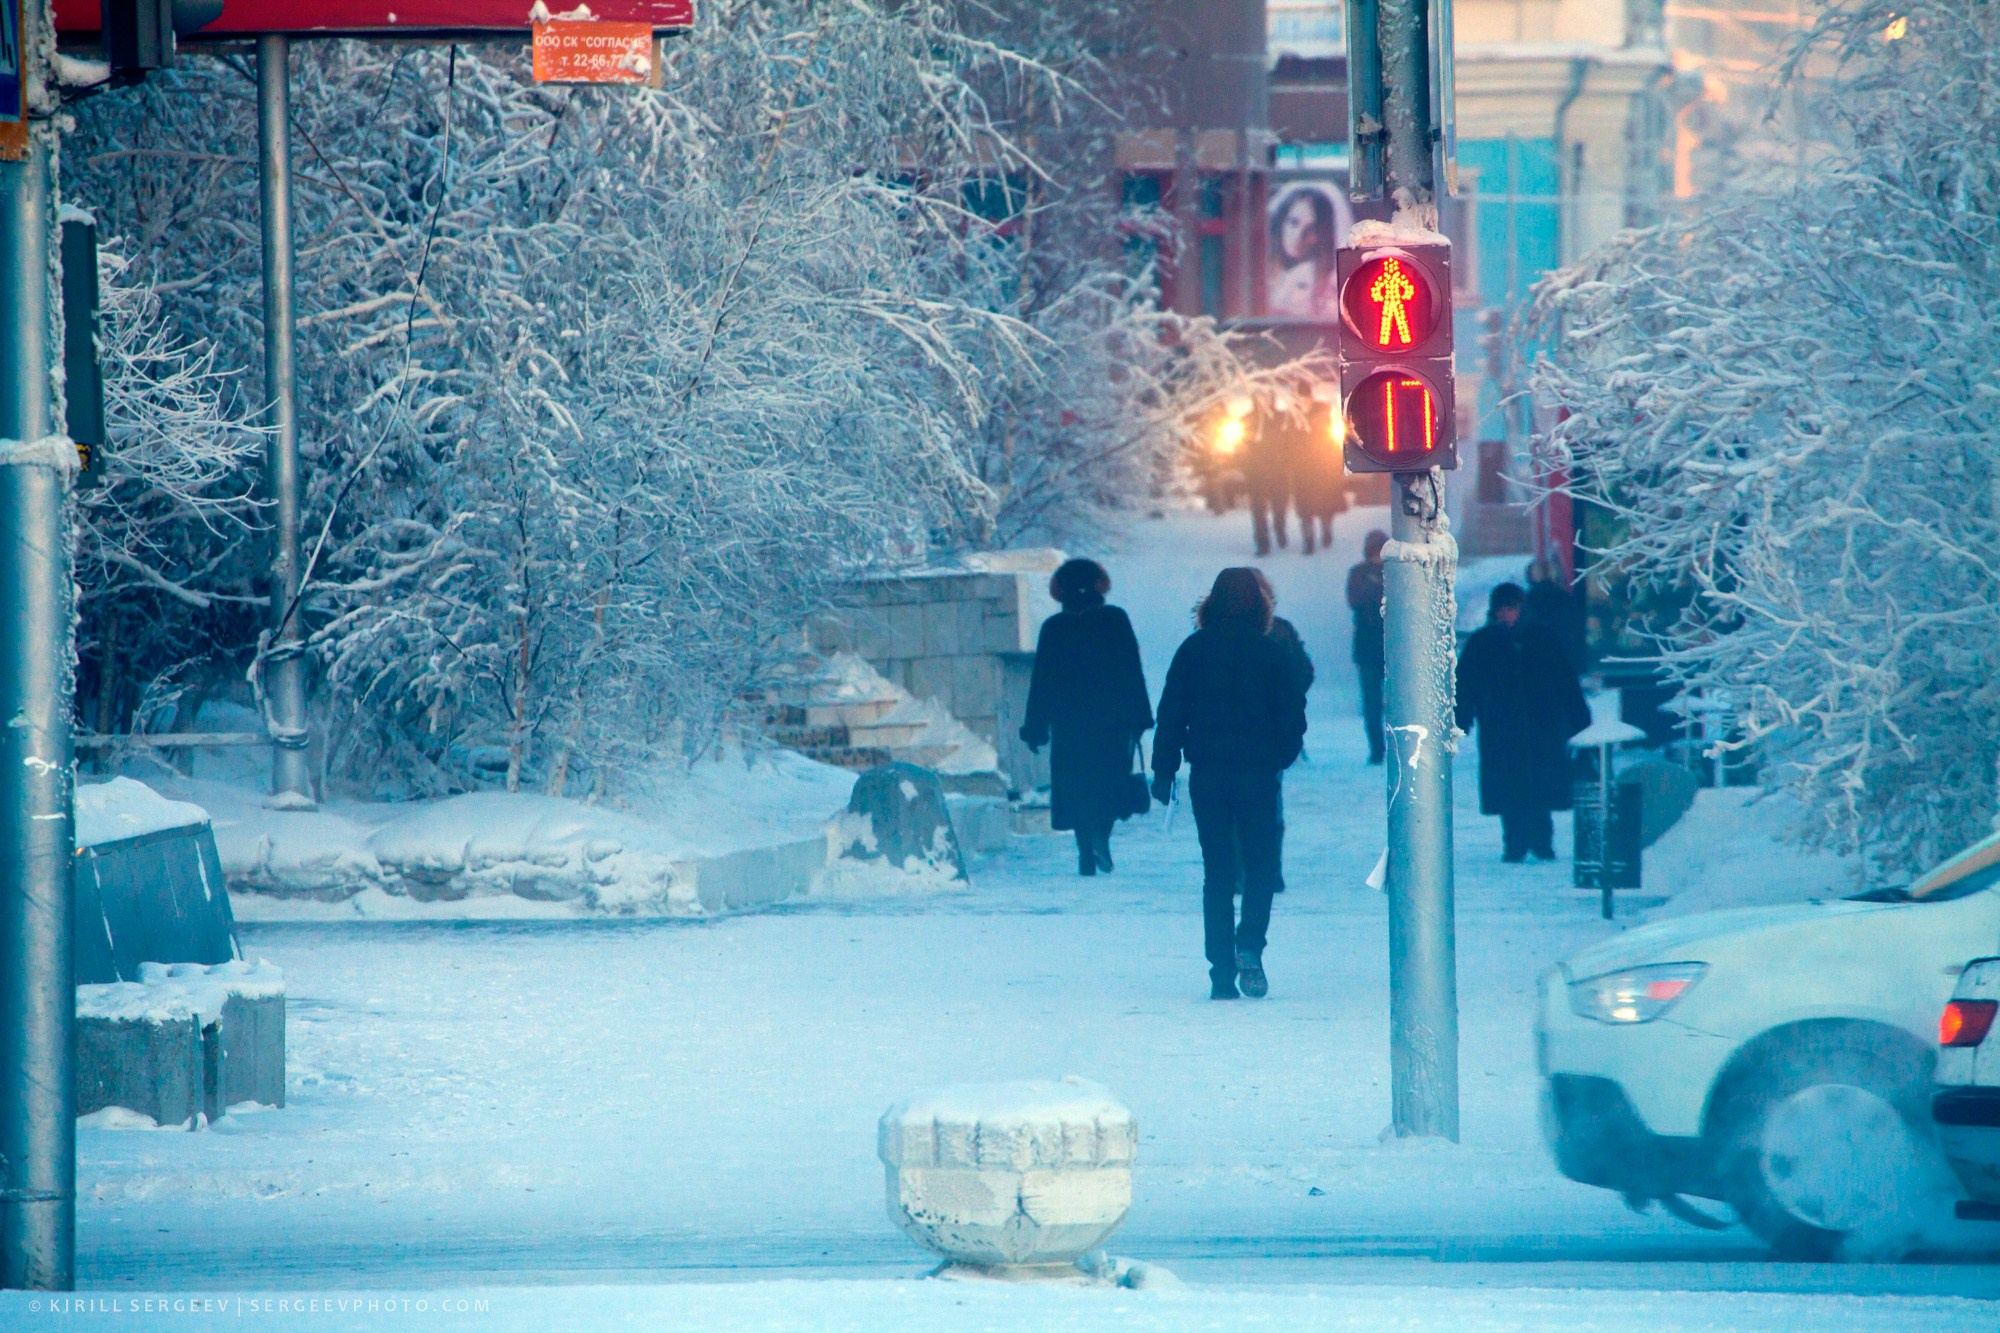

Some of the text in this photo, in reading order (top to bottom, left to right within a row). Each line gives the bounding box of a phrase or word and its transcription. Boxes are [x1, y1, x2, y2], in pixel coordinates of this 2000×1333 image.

[535, 36, 560, 48] ООО
[562, 36, 578, 48] СК
[1384, 380, 1433, 452] 17
